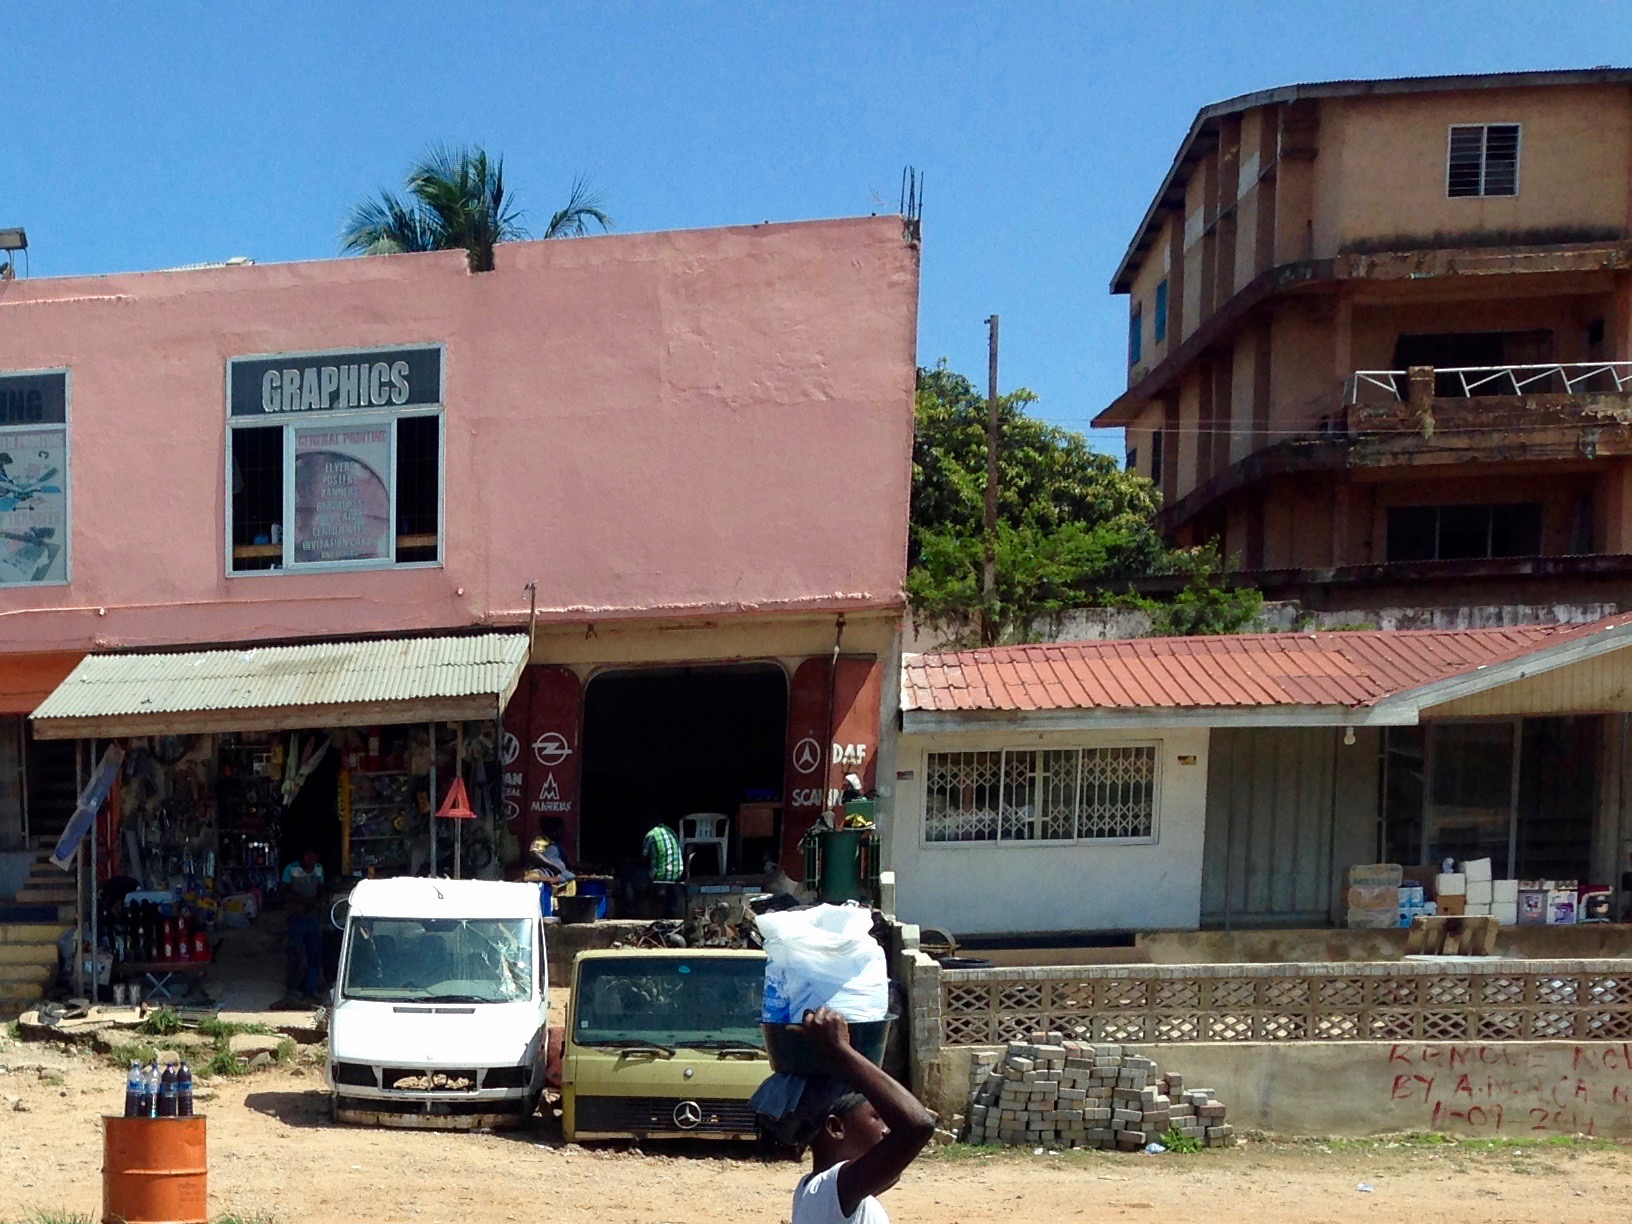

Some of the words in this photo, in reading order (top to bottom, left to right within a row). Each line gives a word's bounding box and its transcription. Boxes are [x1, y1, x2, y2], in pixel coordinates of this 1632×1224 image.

[262, 361, 410, 412] GRAPHICS
[833, 743, 866, 765] DAF
[501, 773, 522, 785] AN
